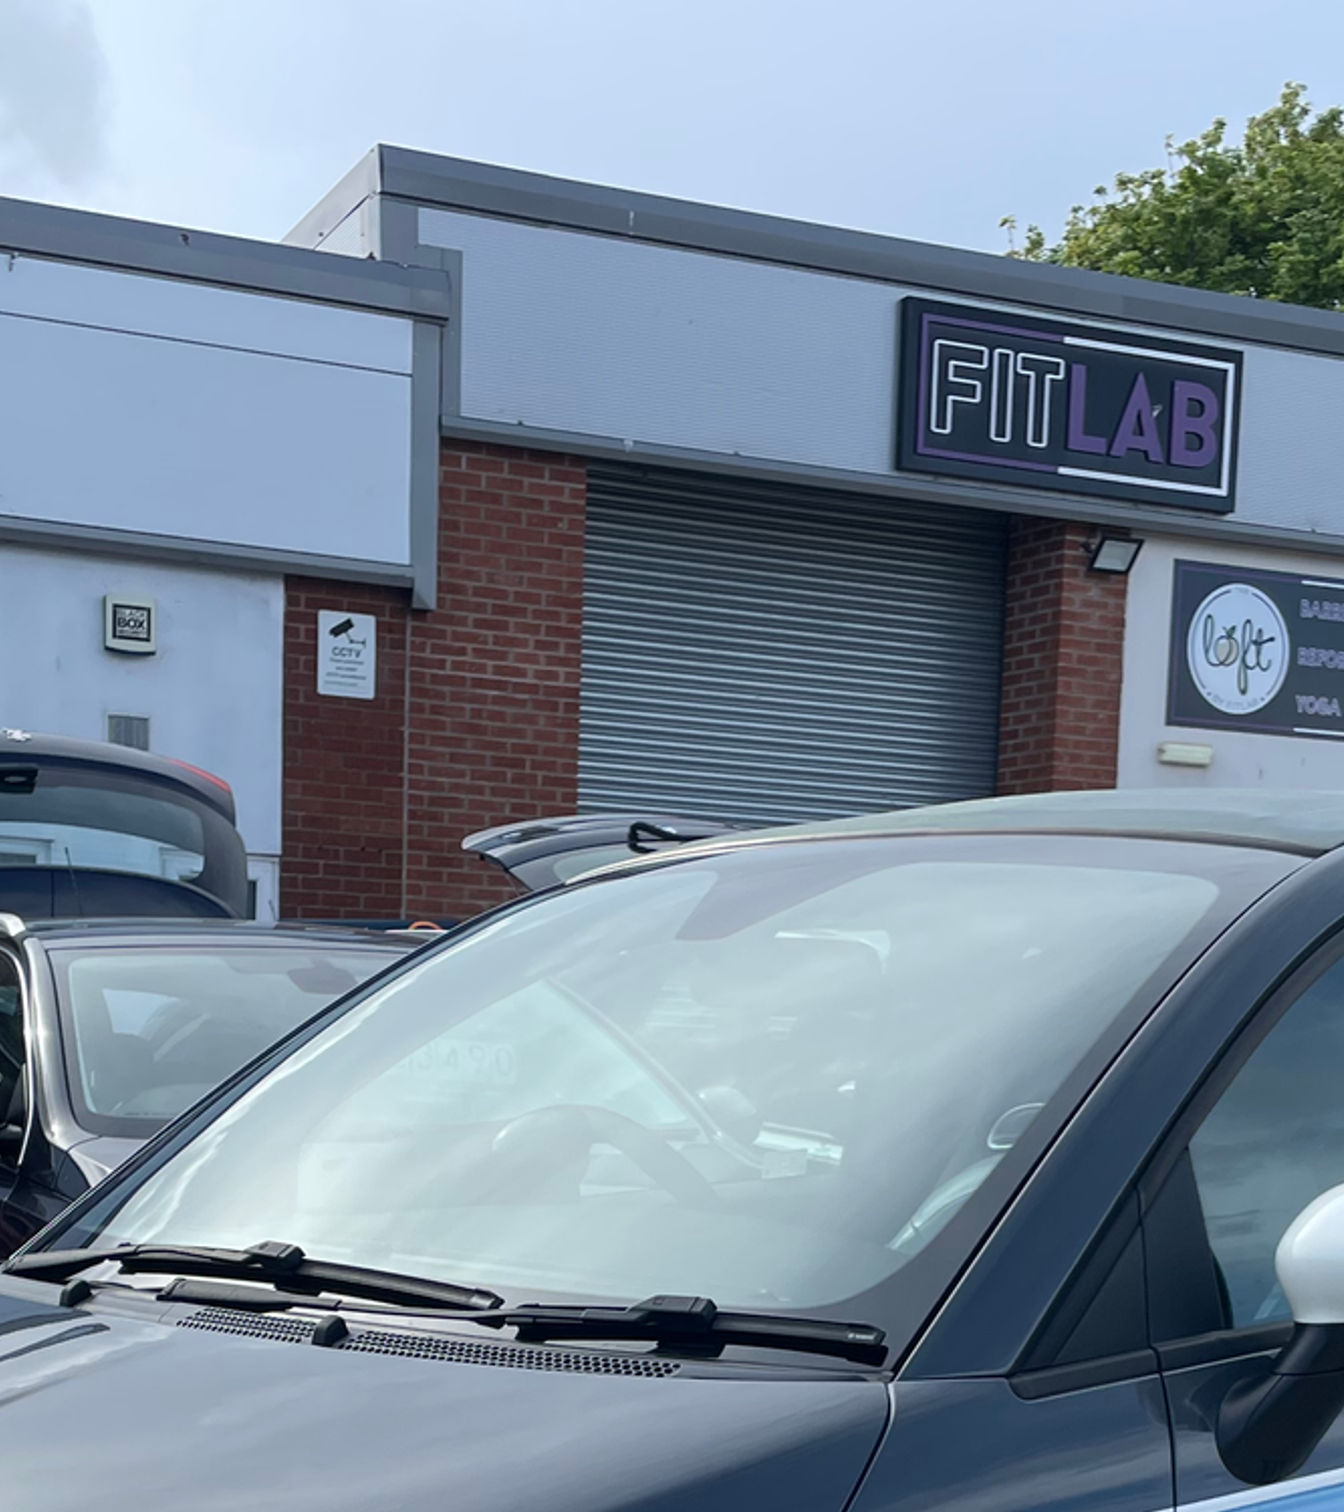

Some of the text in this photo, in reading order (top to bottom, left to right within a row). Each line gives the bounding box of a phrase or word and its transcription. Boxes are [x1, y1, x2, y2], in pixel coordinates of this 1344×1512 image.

[930, 338, 1219, 468] FITLAB
[118, 617, 145, 630] BOX
[331, 646, 362, 658] CCTV
[1295, 695, 1342, 717] YOGA
